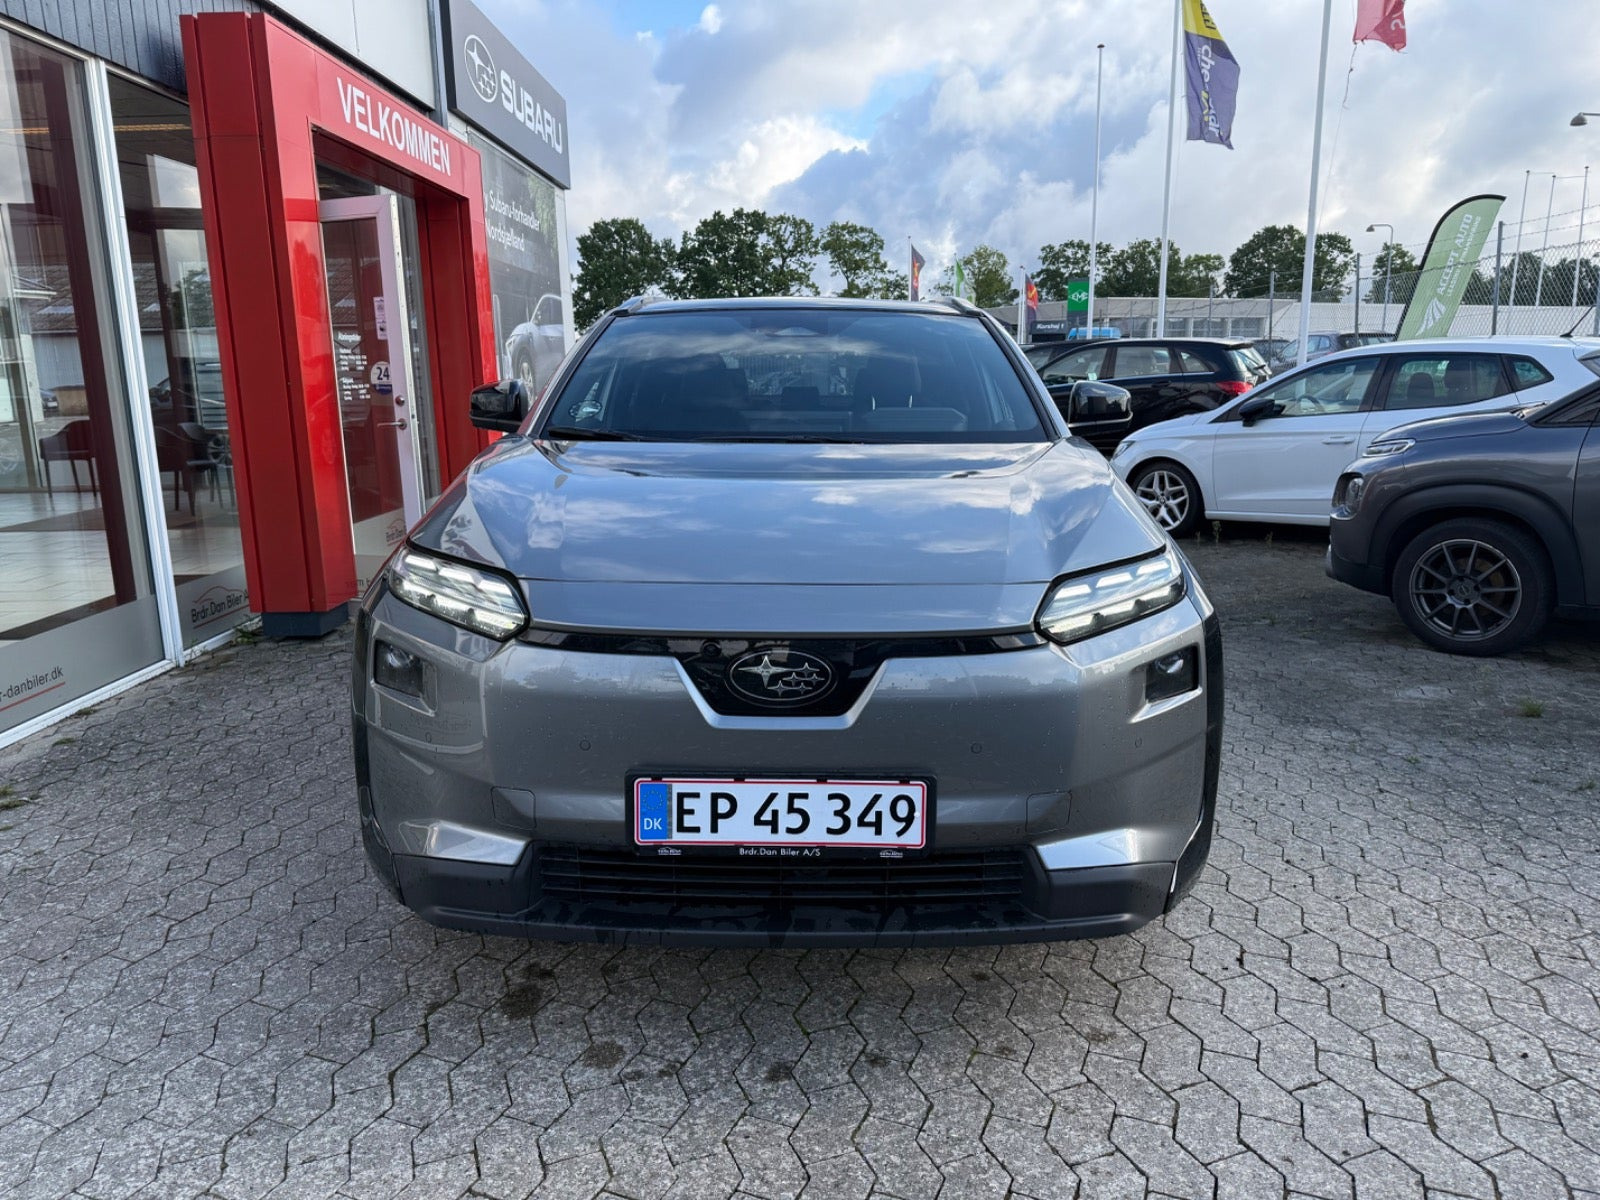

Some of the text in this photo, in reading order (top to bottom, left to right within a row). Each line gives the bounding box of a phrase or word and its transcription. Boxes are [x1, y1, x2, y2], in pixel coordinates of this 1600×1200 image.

[336, 76, 452, 176] VELKOMMEN
[500, 69, 563, 154] SUBARU
[1436, 214, 1473, 296] ACCEPT AUTO
[376, 365, 390, 381] 24
[191, 601, 226, 623] Brdr.Dan
[226, 593, 243, 609] Biler
[643, 817, 663, 831] DK
[676, 791, 916, 838] EP 45 349
[739, 847, 821, 857] Brdr.Dan Biler A/S
